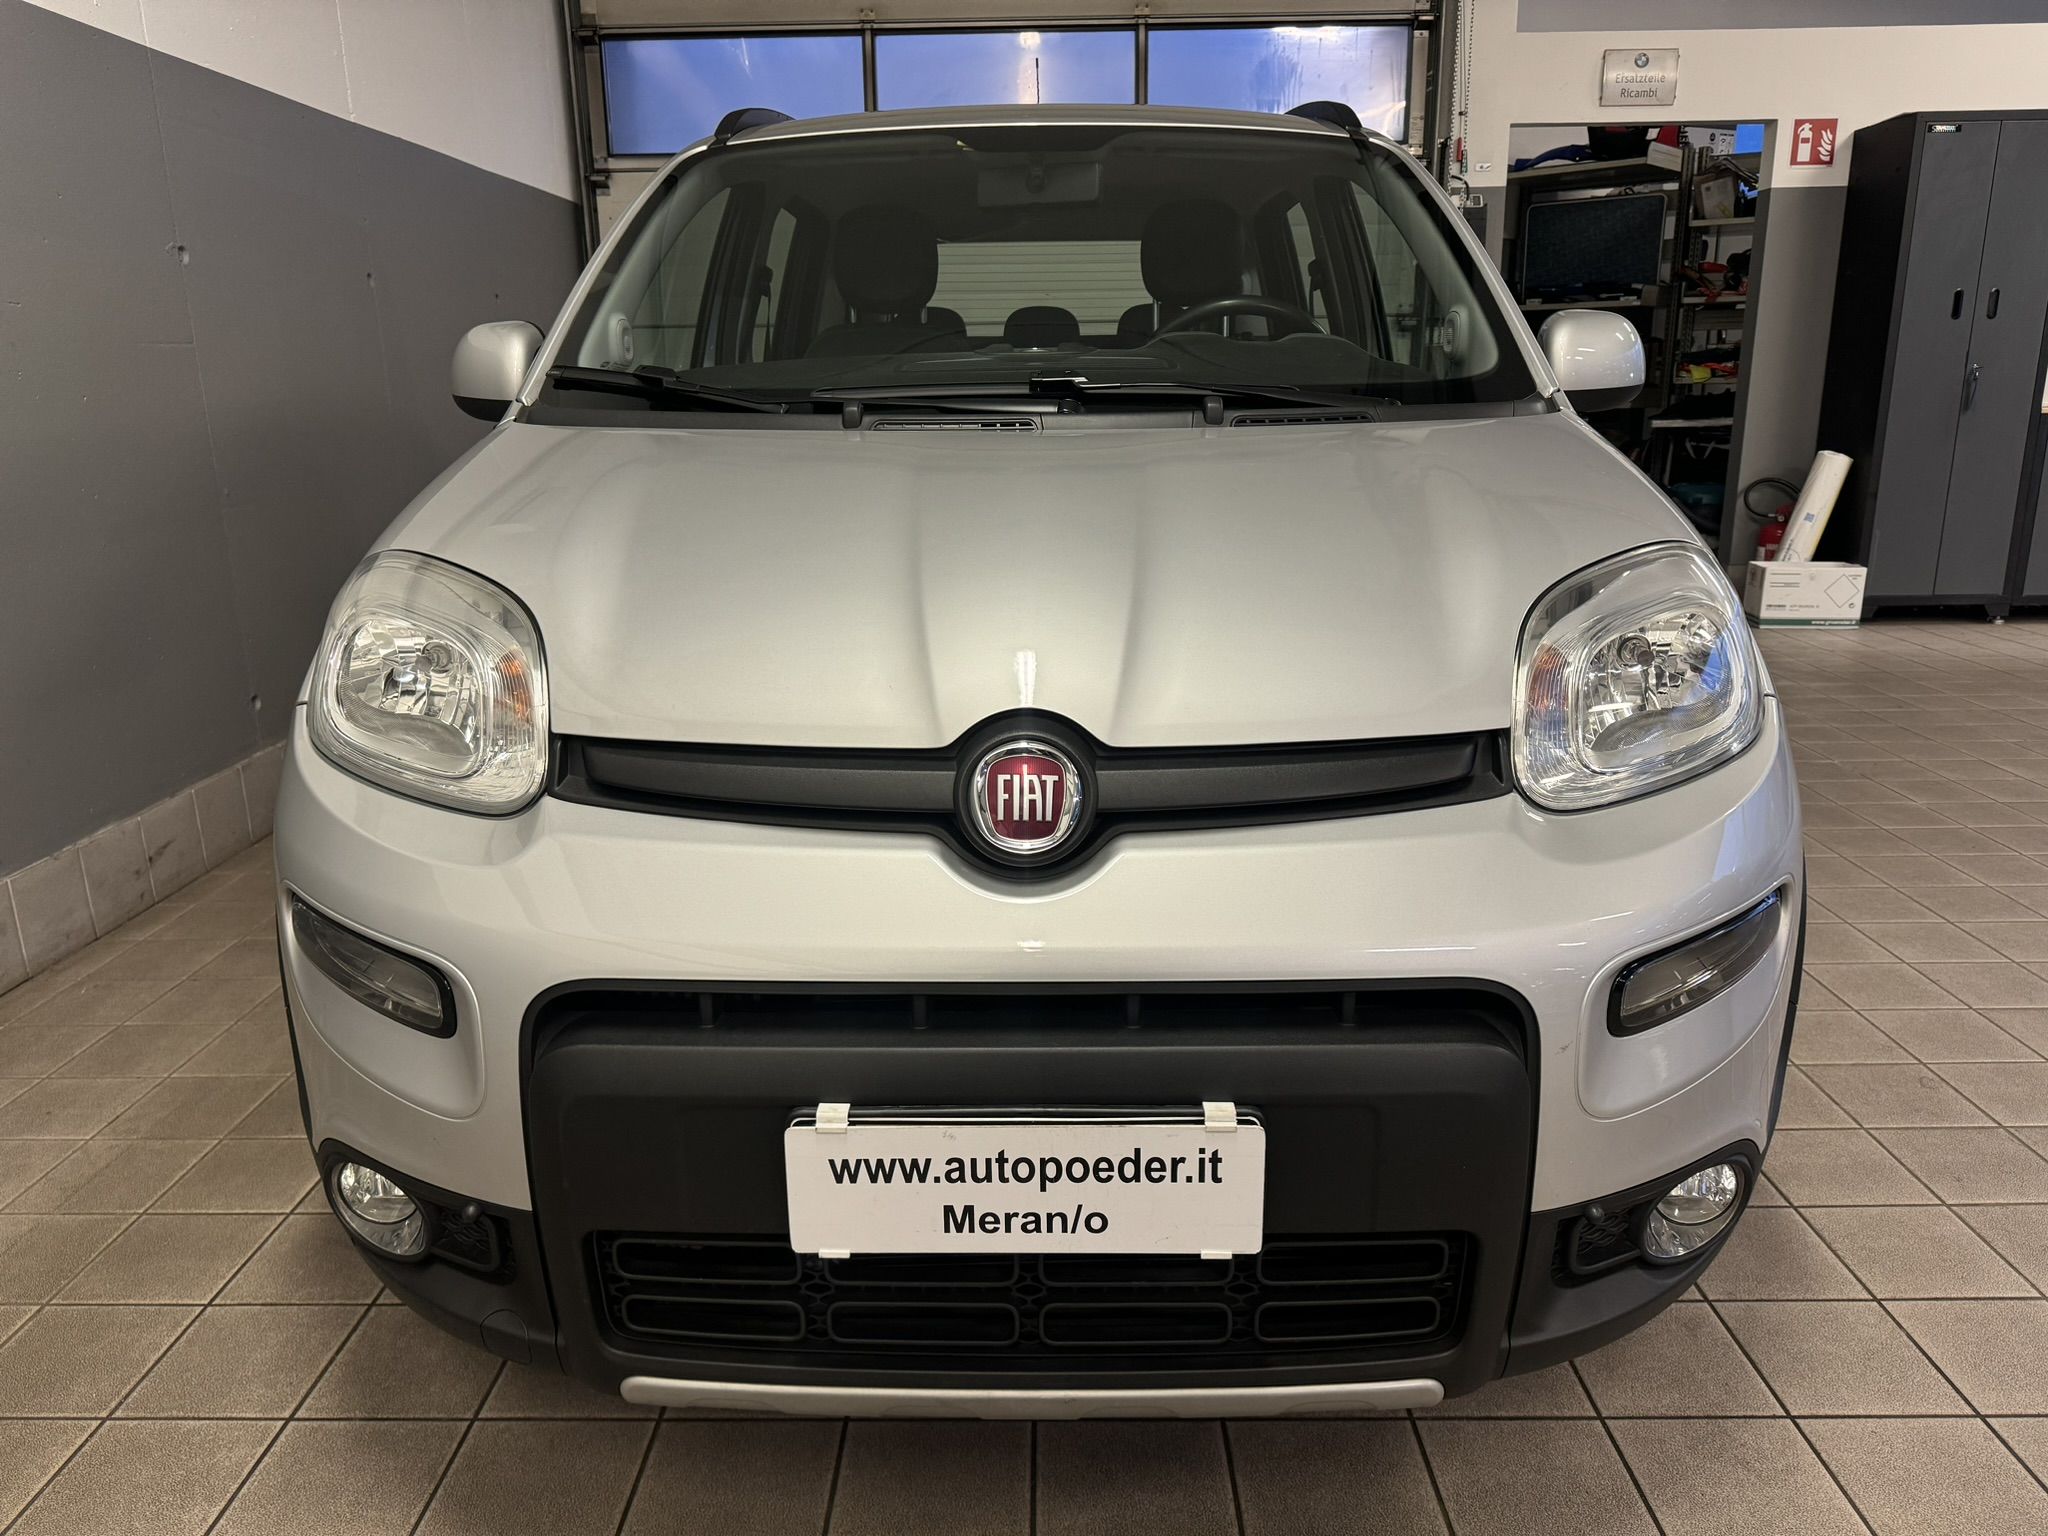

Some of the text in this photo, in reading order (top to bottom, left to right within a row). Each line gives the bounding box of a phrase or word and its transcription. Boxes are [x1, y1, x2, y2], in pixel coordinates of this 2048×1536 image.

[1615, 73, 1666, 84] Ersatzteile
[1620, 87, 1658, 98] Ricambi
[997, 774, 1059, 822] FIAT
[828, 1147, 1223, 1193] www.autopoeder.it
[943, 1204, 1109, 1235] Meran/o
